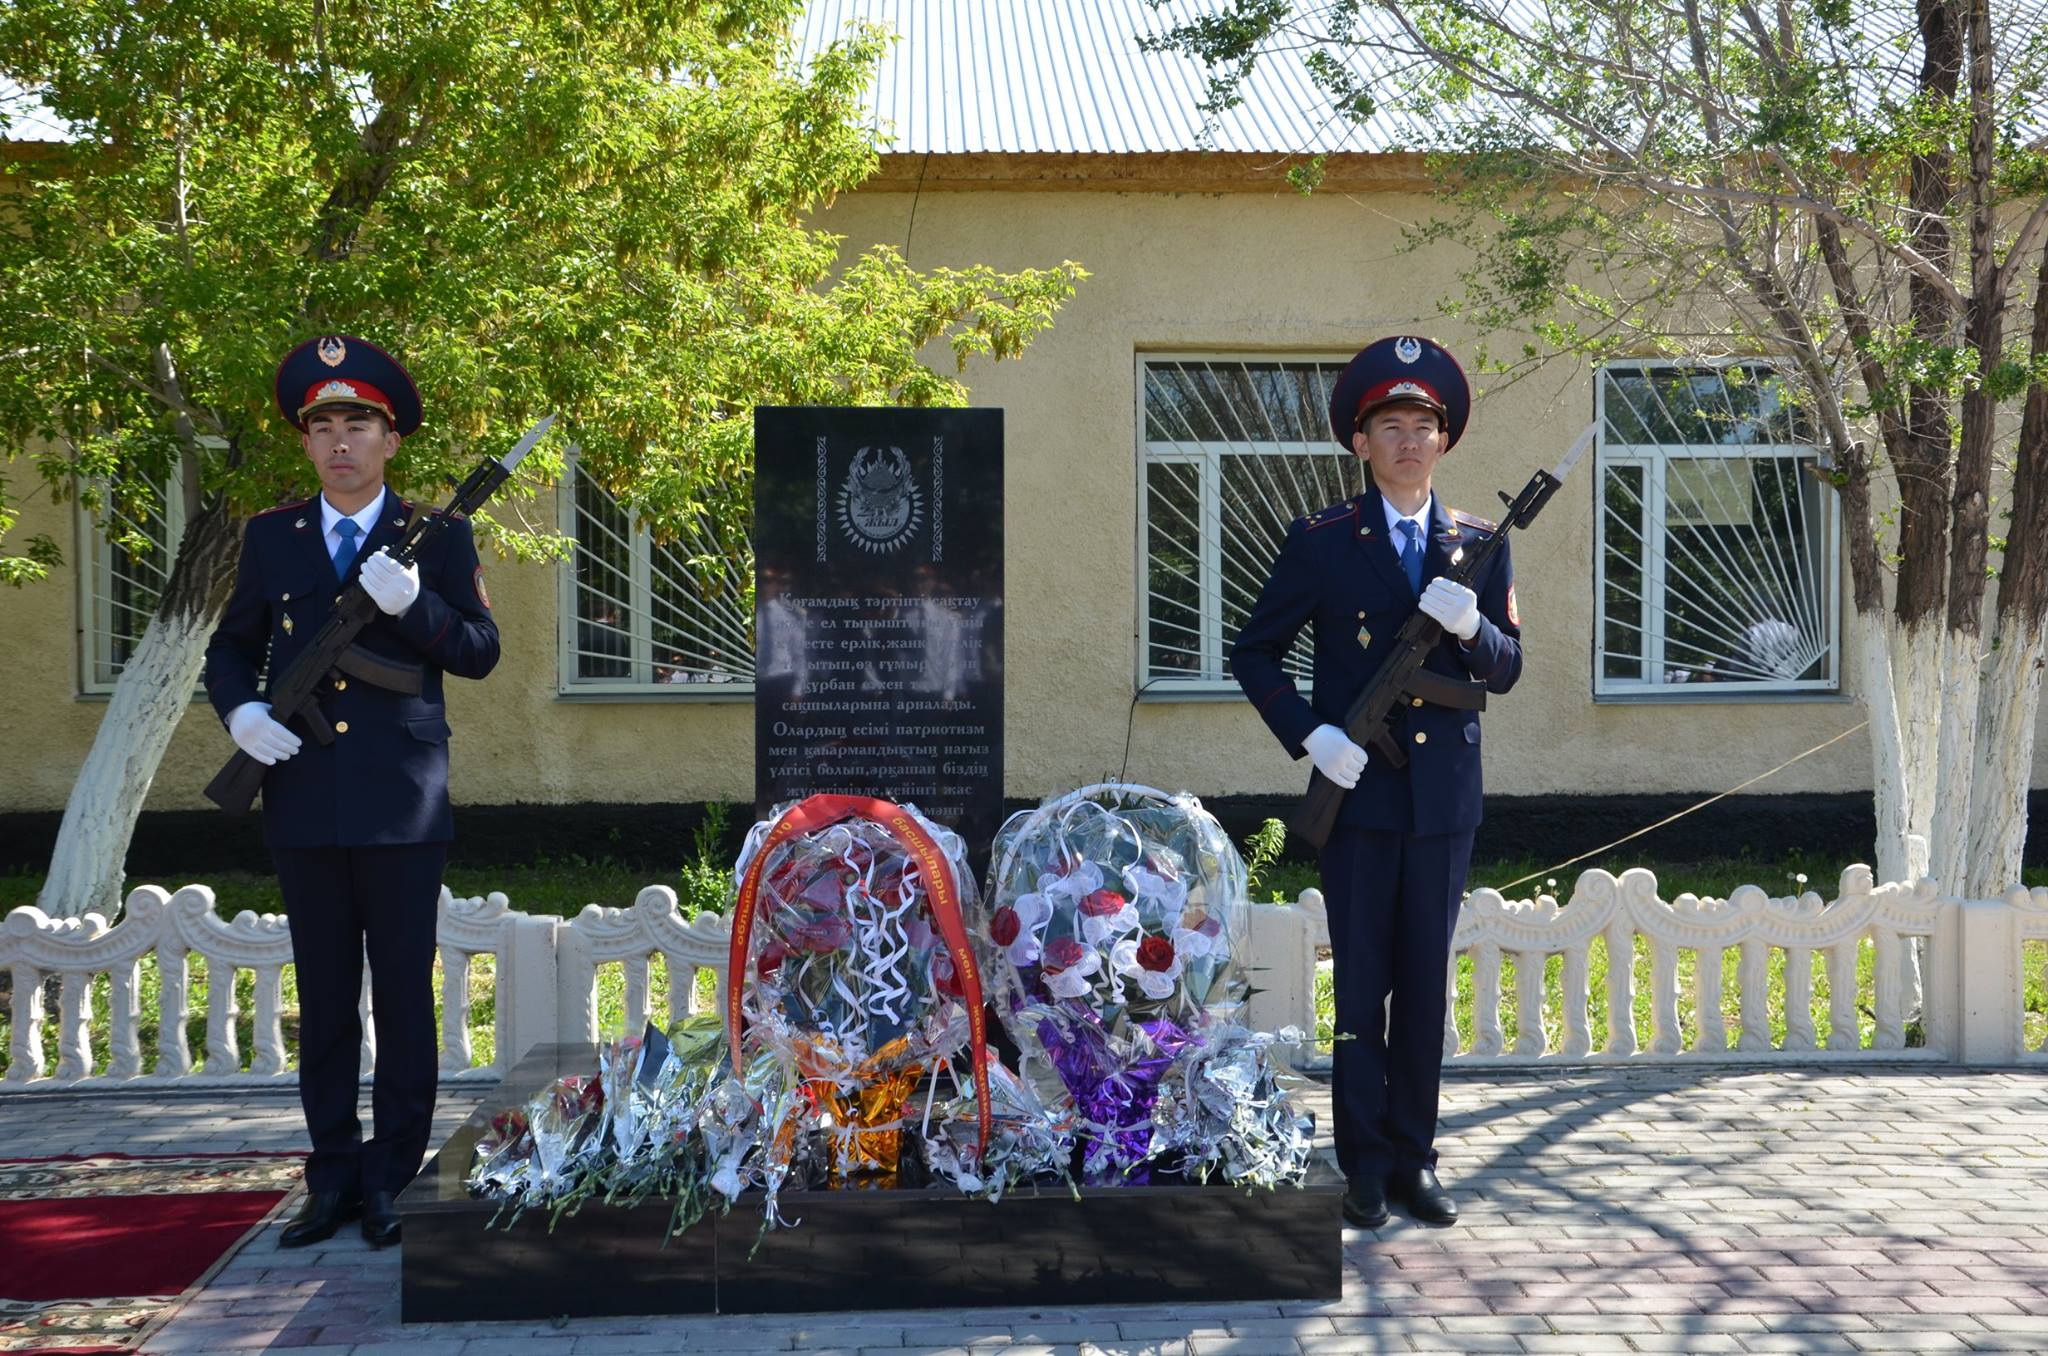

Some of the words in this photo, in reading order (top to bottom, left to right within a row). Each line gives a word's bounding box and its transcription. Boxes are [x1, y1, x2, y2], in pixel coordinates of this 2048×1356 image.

[820, 620, 837, 629] ел
[782, 701, 890, 713] сақшыларына
[897, 701, 977, 713] арналады.
[773, 721, 847, 739] Олардың
[853, 722, 889, 736] есімі
[896, 726, 985, 738] патриотизм
[768, 746, 797, 756] мен
[944, 745, 990, 755] нағыз
[943, 761, 989, 776] біздің
[944, 786, 973, 796] жас
[893, 816, 948, 905] басшылары
[958, 947, 974, 980] мен
